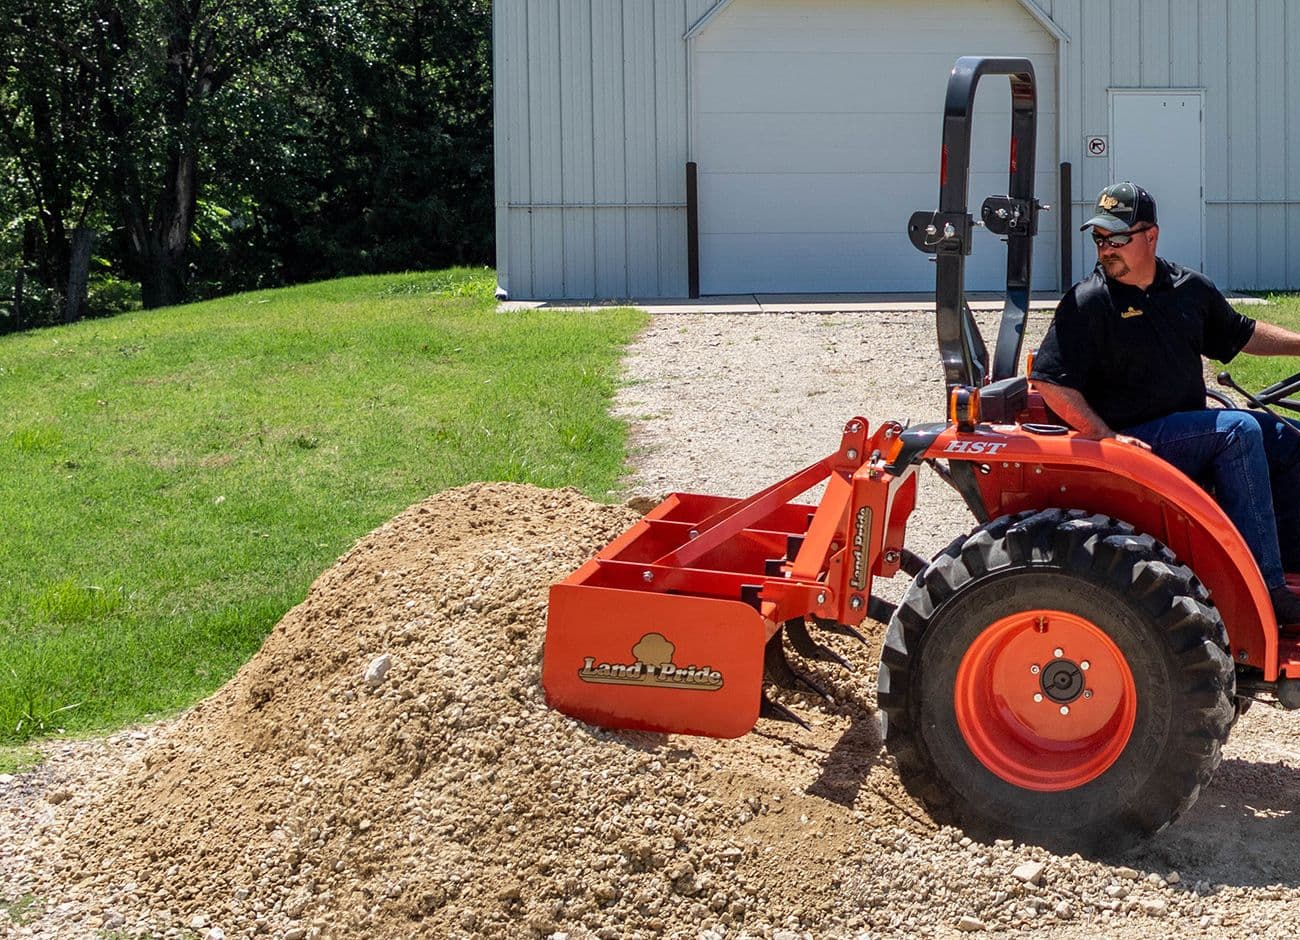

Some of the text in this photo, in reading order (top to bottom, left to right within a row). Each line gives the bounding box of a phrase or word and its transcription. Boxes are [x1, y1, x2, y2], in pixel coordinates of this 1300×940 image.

[943, 440, 1007, 455] HST
[849, 507, 865, 588] Land Pride
[580, 656, 722, 685] Land Pride
